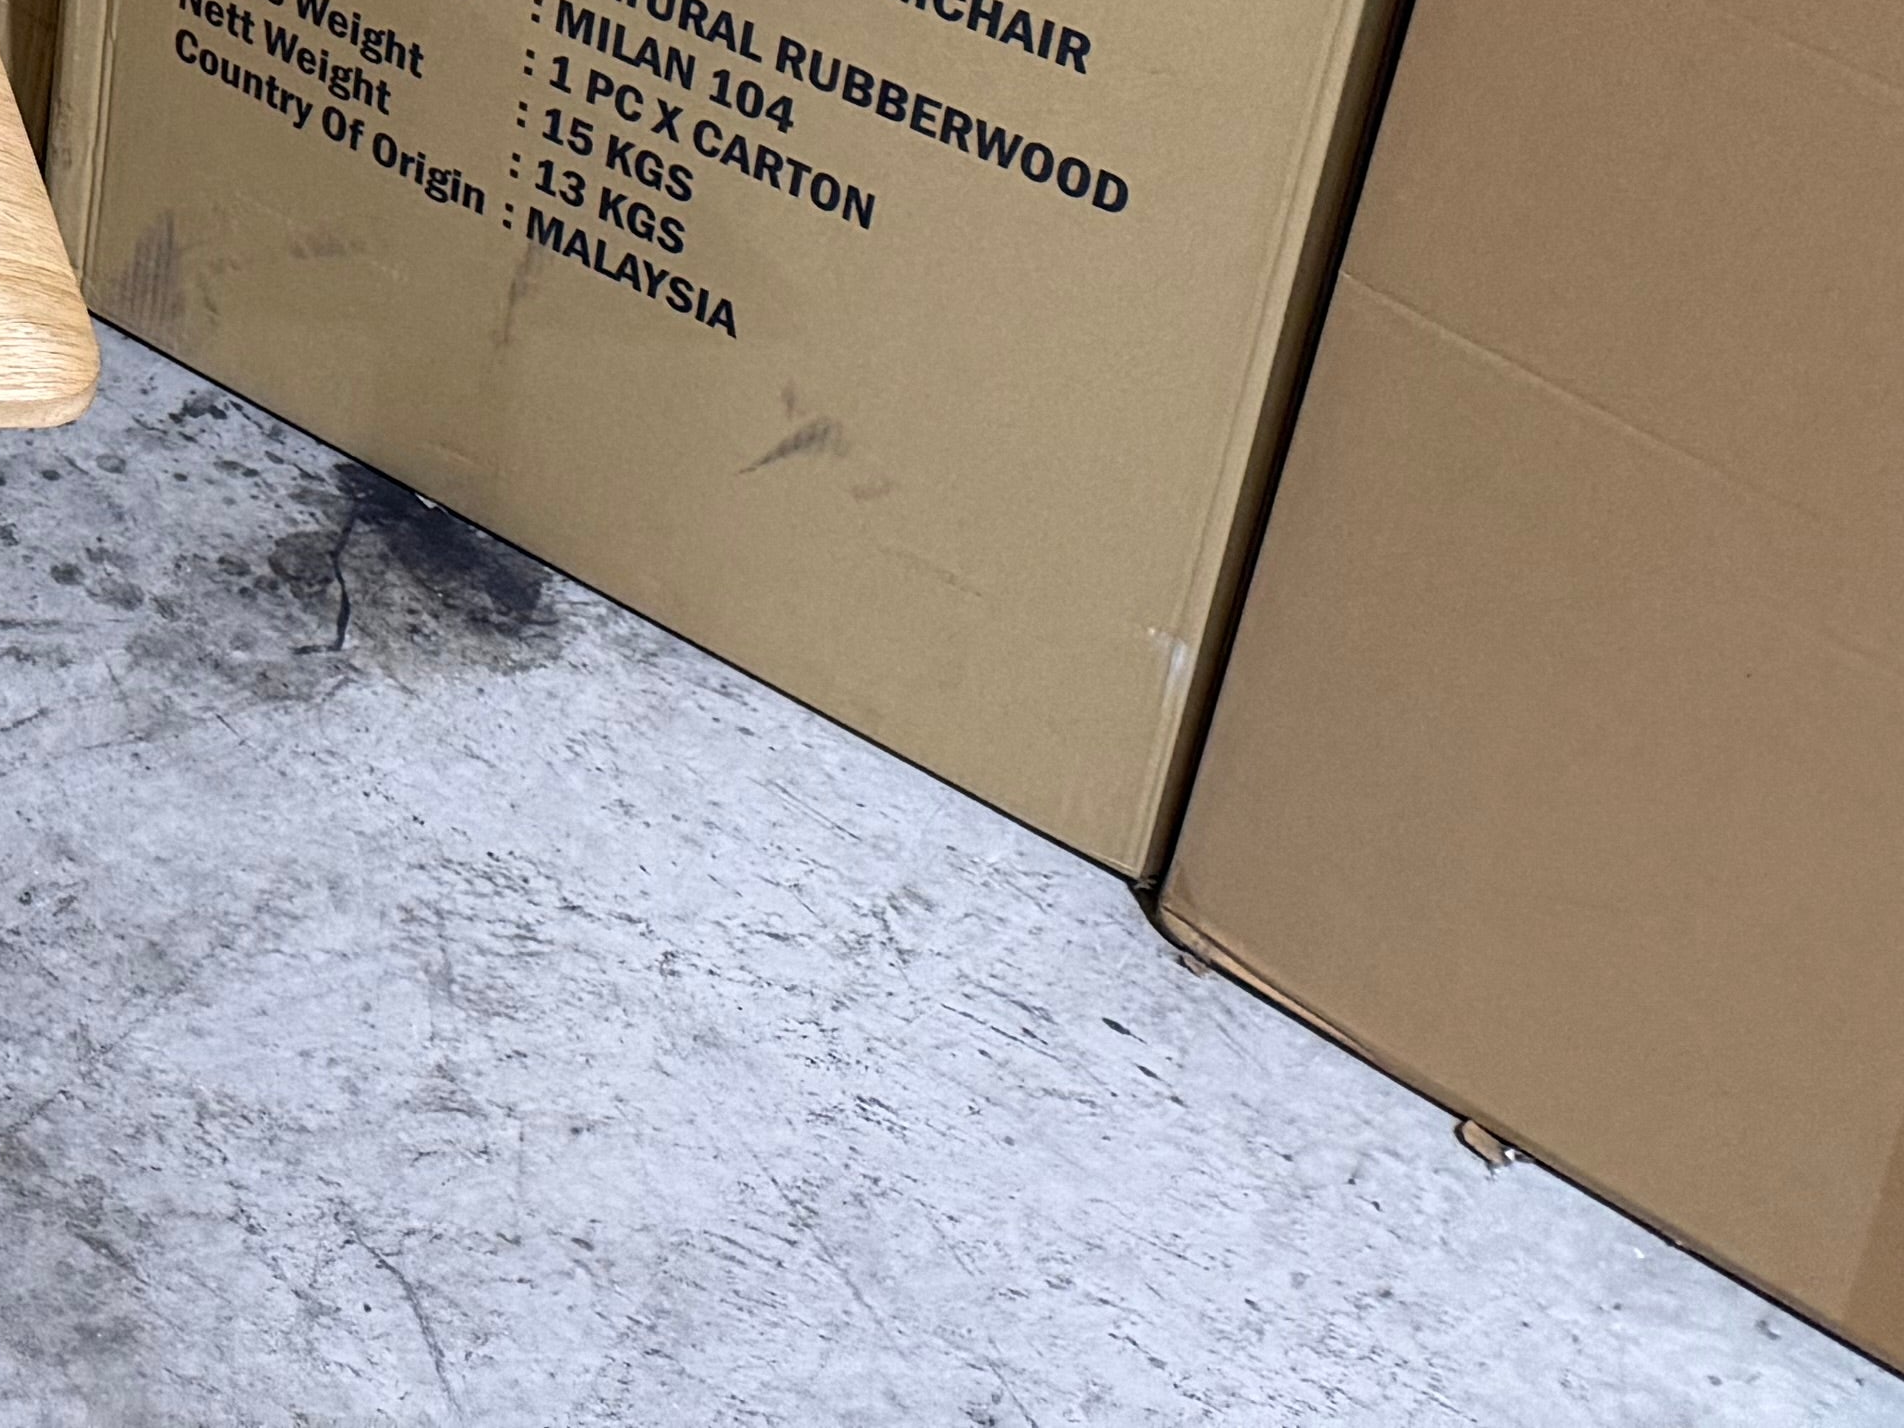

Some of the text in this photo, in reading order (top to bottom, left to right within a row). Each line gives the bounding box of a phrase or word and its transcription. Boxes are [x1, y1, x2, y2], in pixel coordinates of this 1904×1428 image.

[174, 28, 737, 339] Country Of Origin MALAYSIA
[548, 55, 572, 94] 1
[585, 68, 644, 123] PC
[650, 98, 684, 144] X
[692, 119, 876, 230] CARTON
